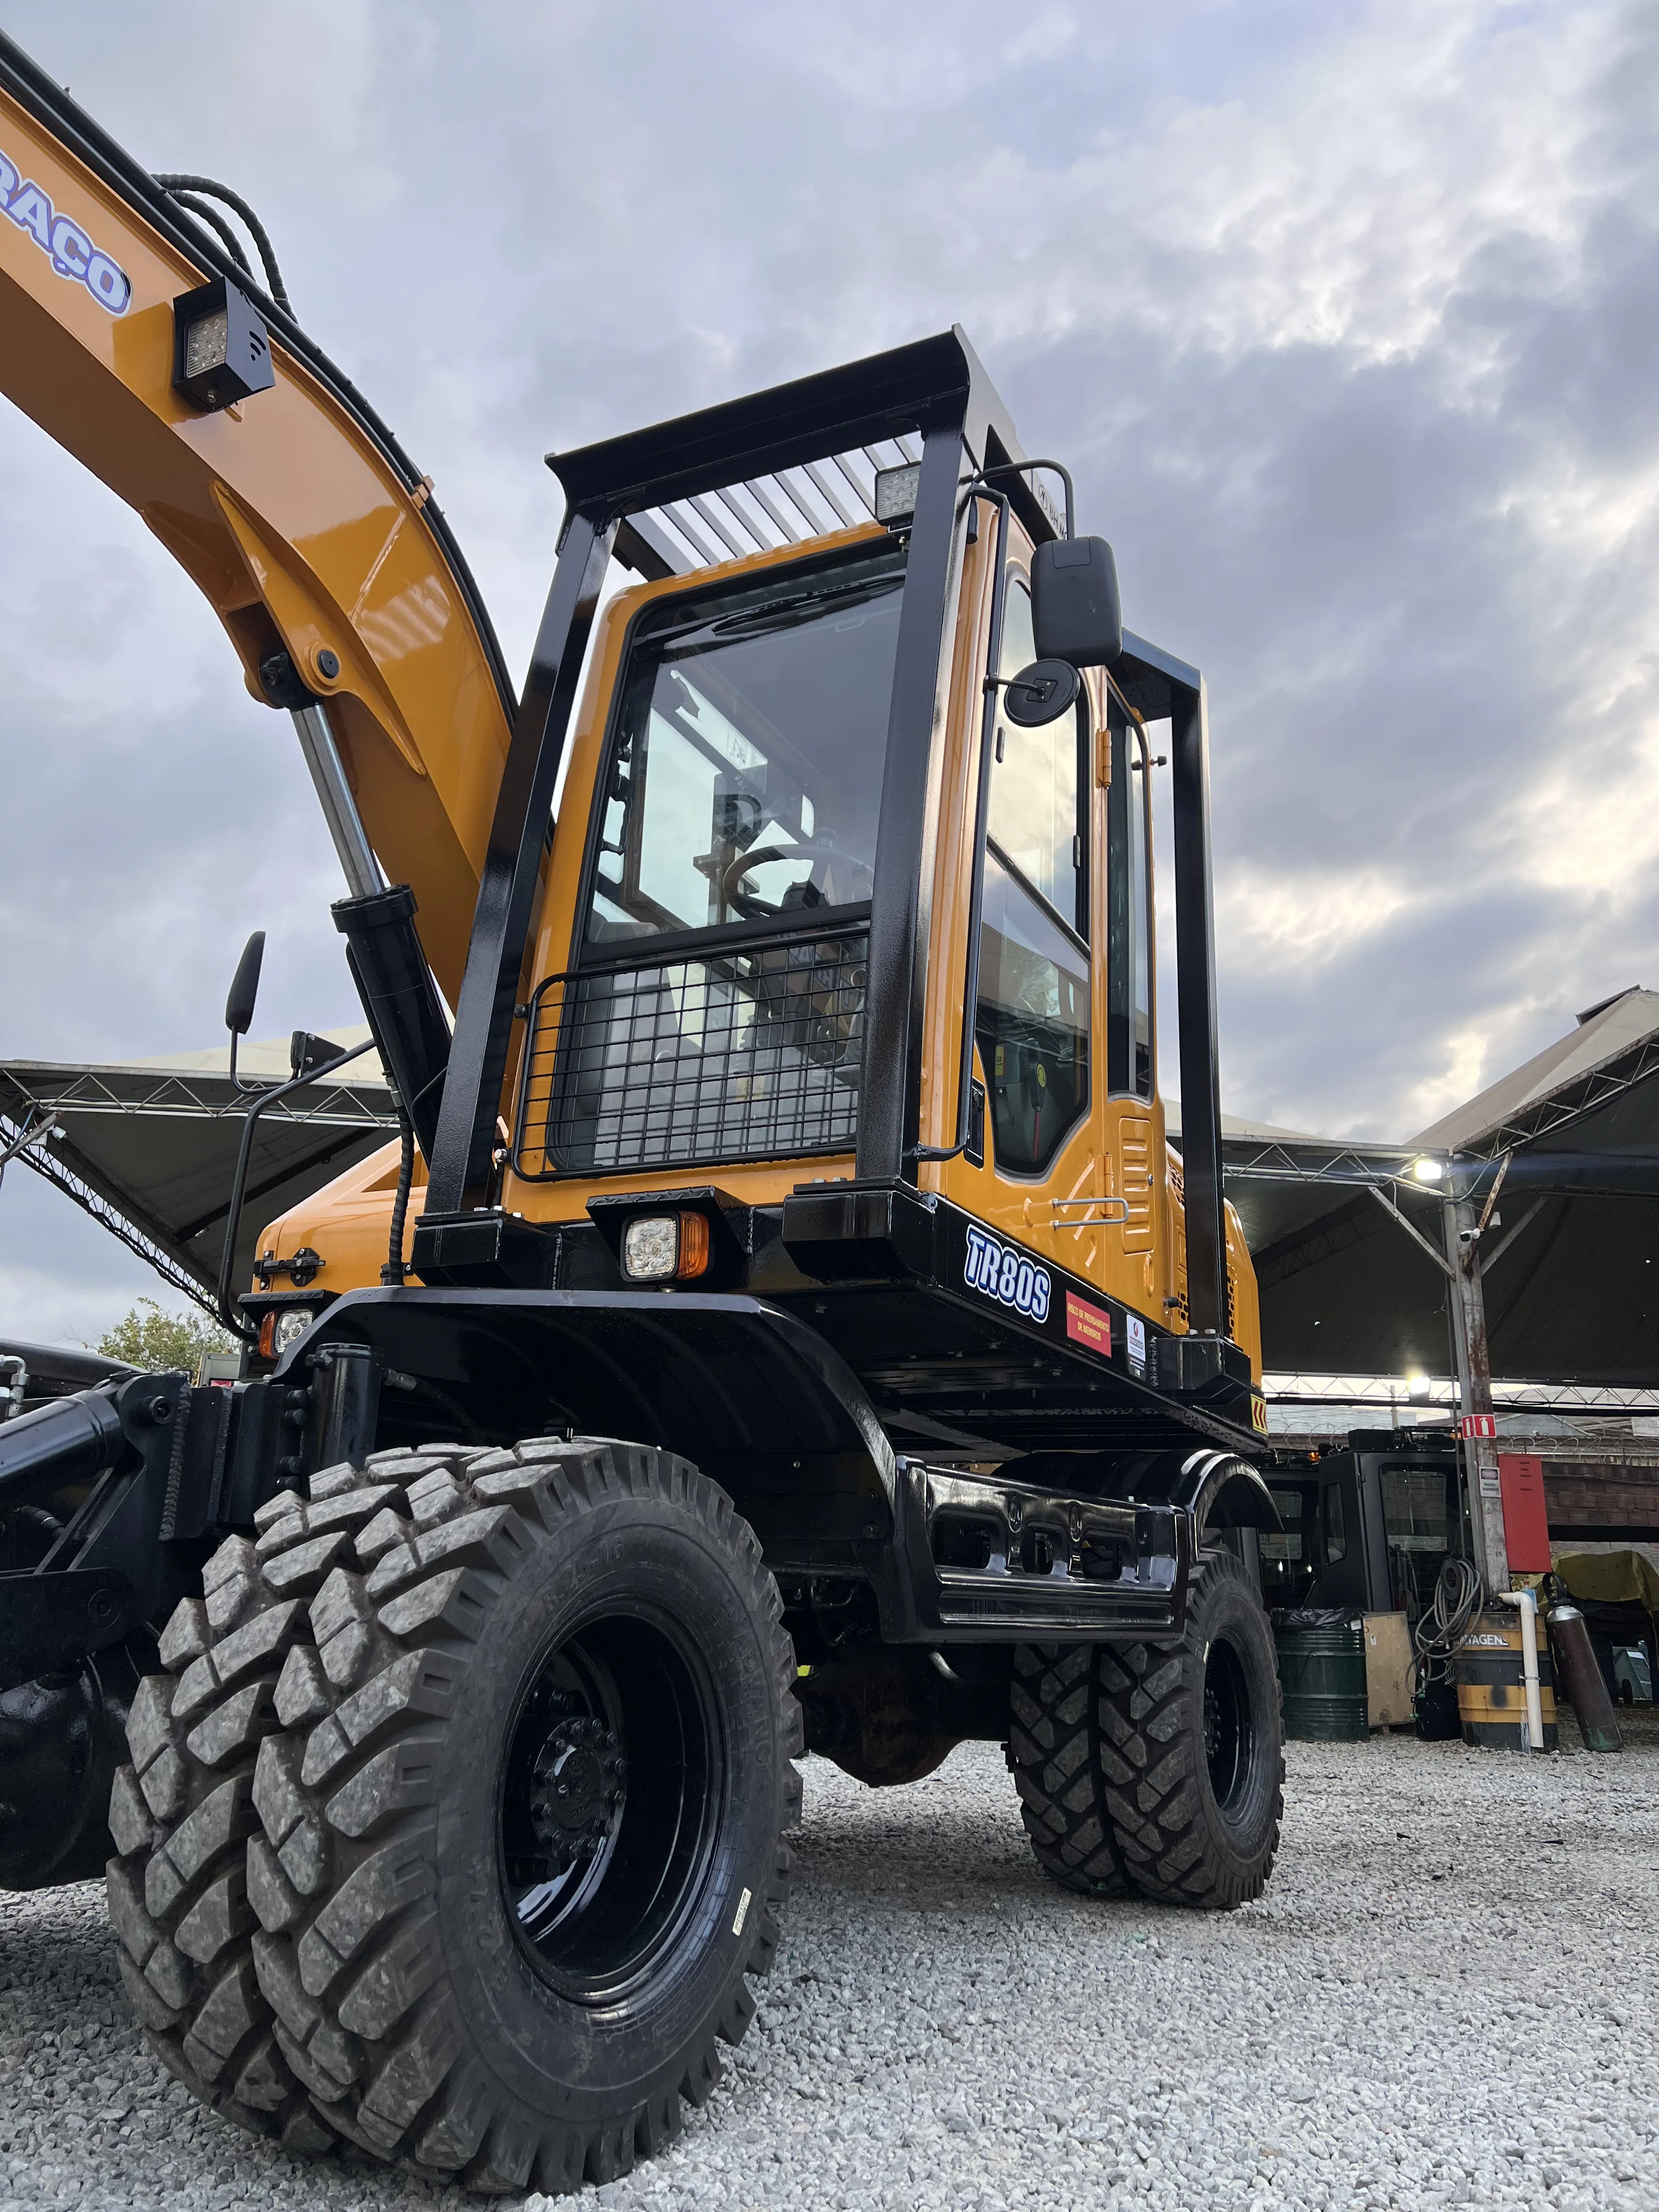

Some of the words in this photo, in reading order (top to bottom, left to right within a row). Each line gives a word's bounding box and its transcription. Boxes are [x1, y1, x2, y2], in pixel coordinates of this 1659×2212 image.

[965, 1227, 1050, 1321] TR80S
[1068, 1302, 1079, 1316] RISCO
[1079, 1308, 1084, 1319] DE
[1084, 1311, 1109, 1333] PRENSAMENTO
[1077, 1321, 1083, 1332] DE
[1083, 1324, 1102, 1341] MEMBROS
